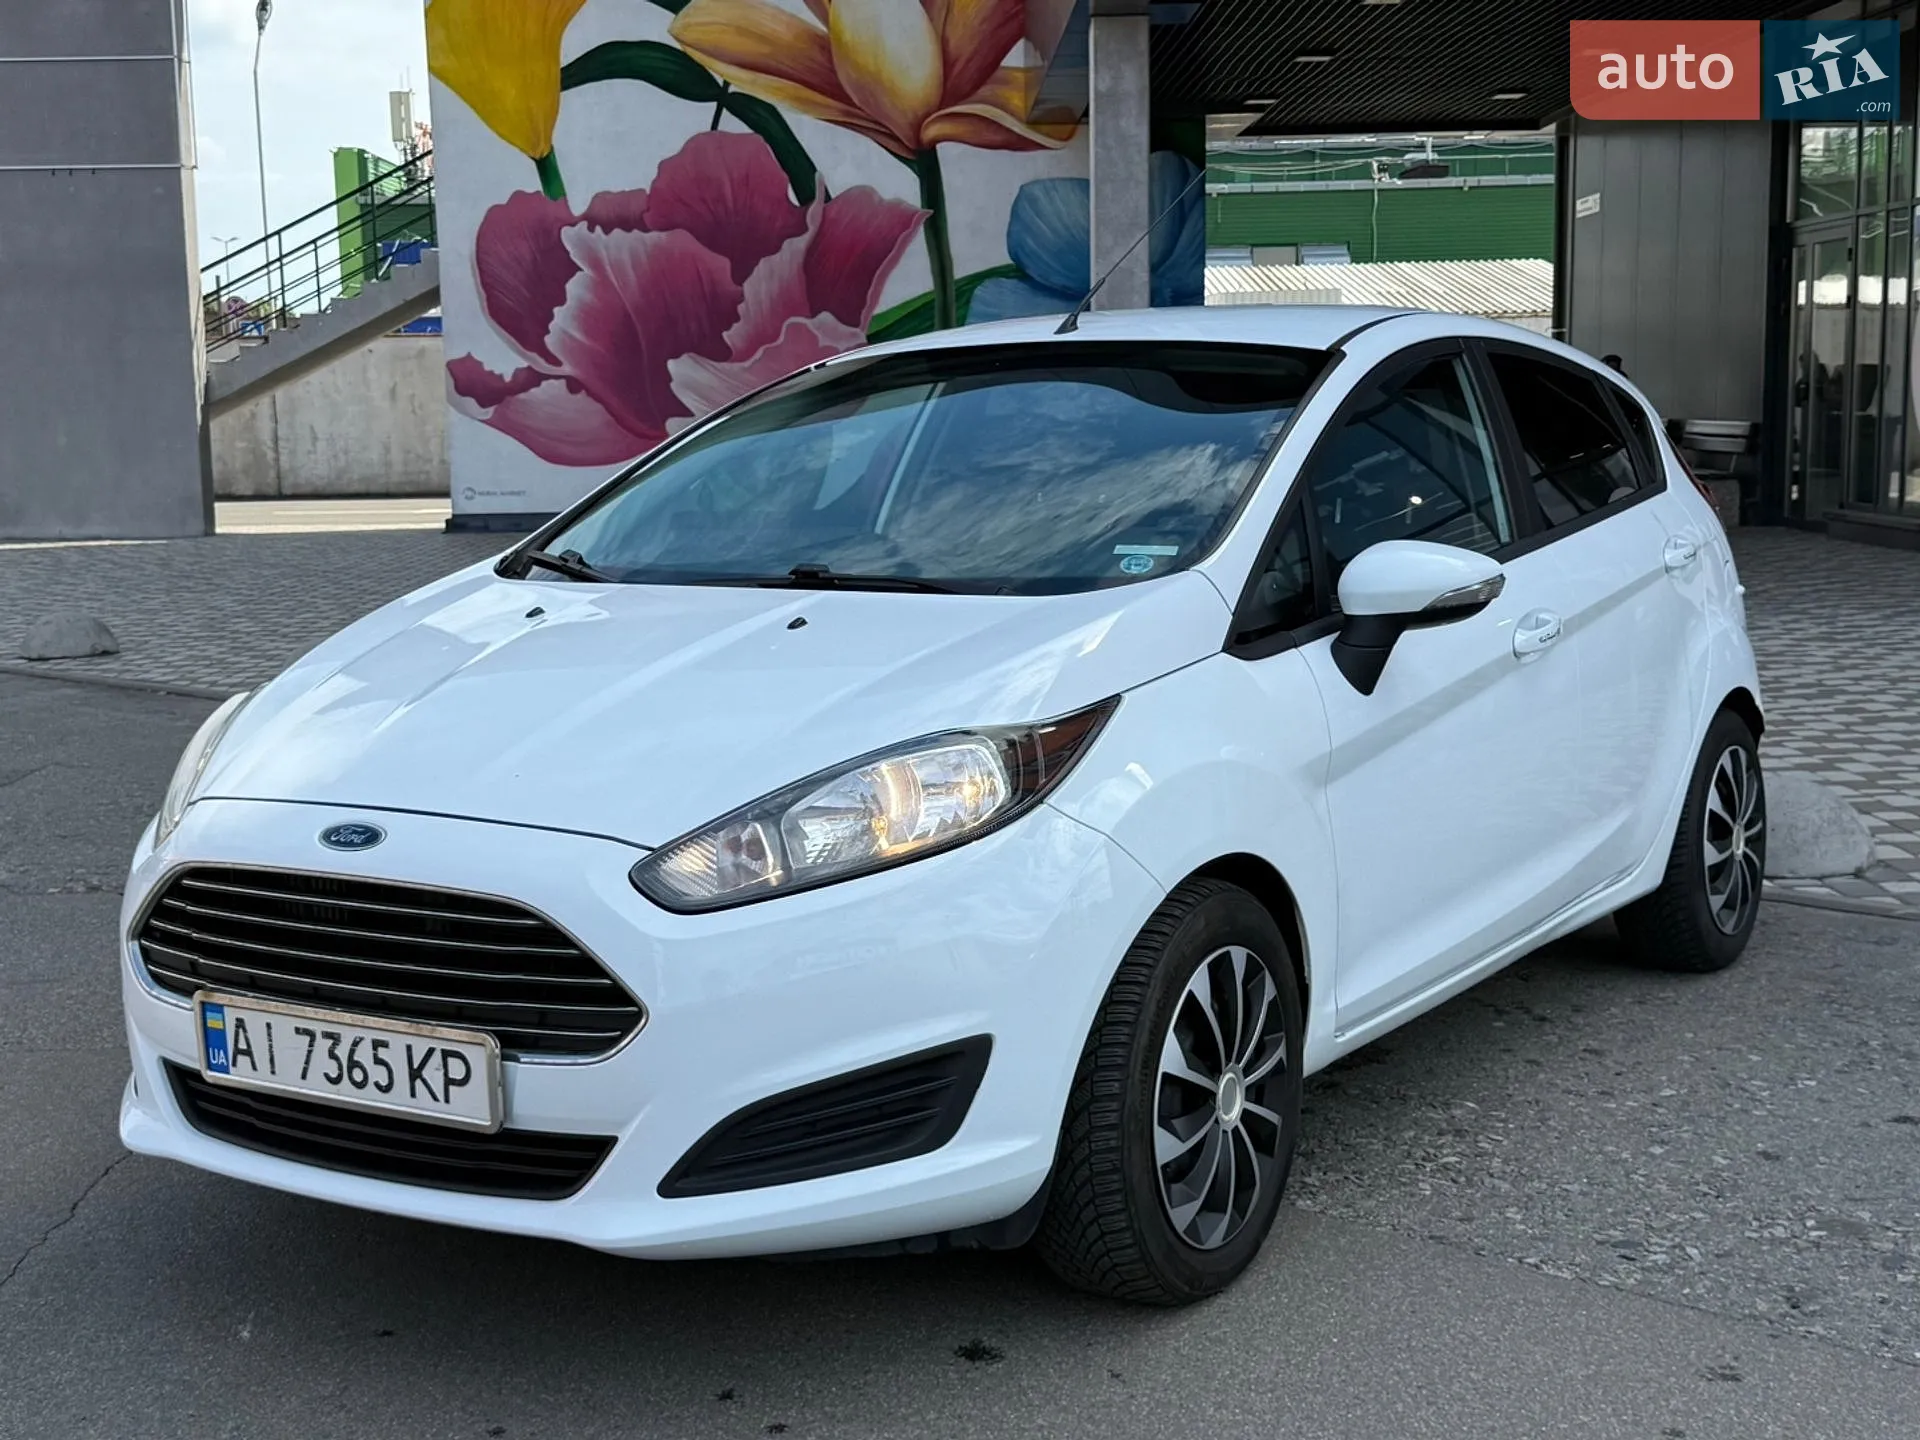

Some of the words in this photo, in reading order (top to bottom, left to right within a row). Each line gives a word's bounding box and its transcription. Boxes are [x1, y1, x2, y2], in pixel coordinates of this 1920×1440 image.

[330, 825, 372, 843] Ford
[208, 1050, 228, 1067] UA
[231, 1017, 276, 1076] AI
[294, 1026, 394, 1094] 7365
[405, 1043, 473, 1105] KP
